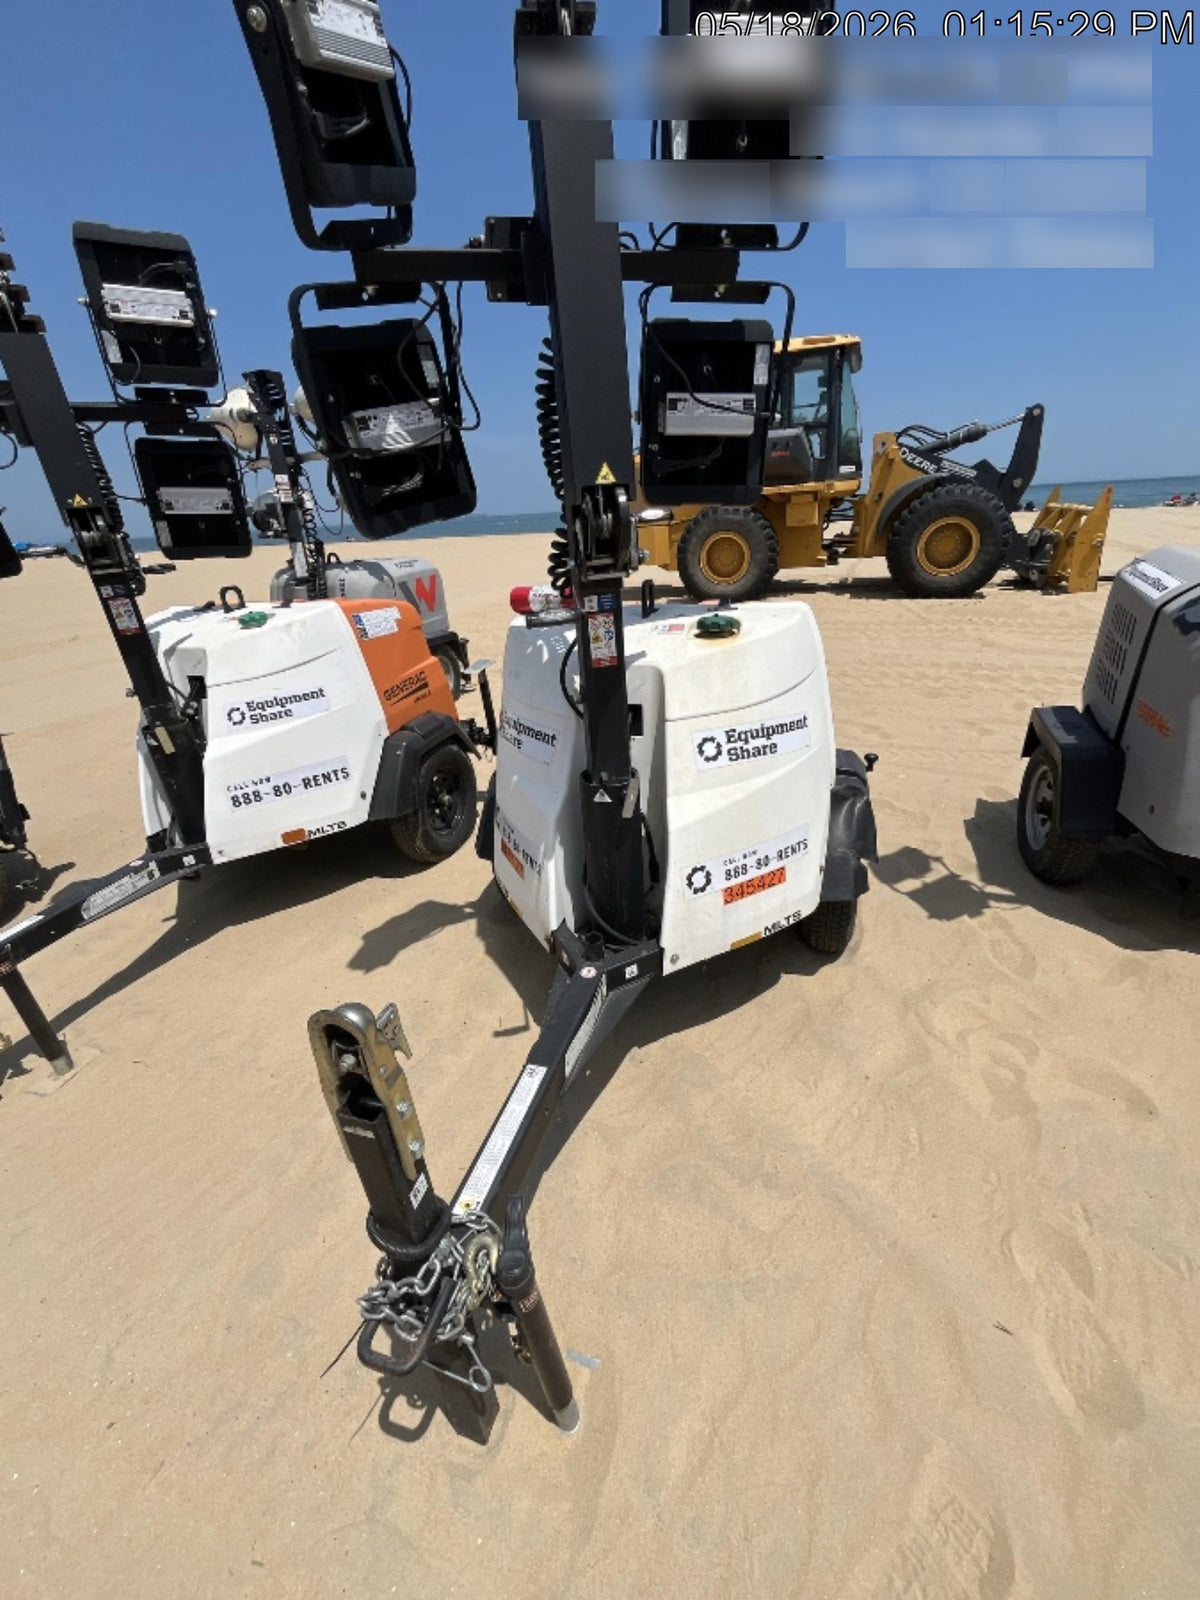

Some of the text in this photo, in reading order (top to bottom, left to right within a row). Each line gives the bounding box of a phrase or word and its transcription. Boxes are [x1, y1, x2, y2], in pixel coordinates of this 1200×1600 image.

[900, 447, 938, 475] DEERE
[245, 688, 326, 712] Equipment
[250, 709, 293, 725] Share
[724, 714, 808, 745] Equipment
[727, 742, 778, 762] Share
[231, 767, 350, 808] 888-80-RENTS
